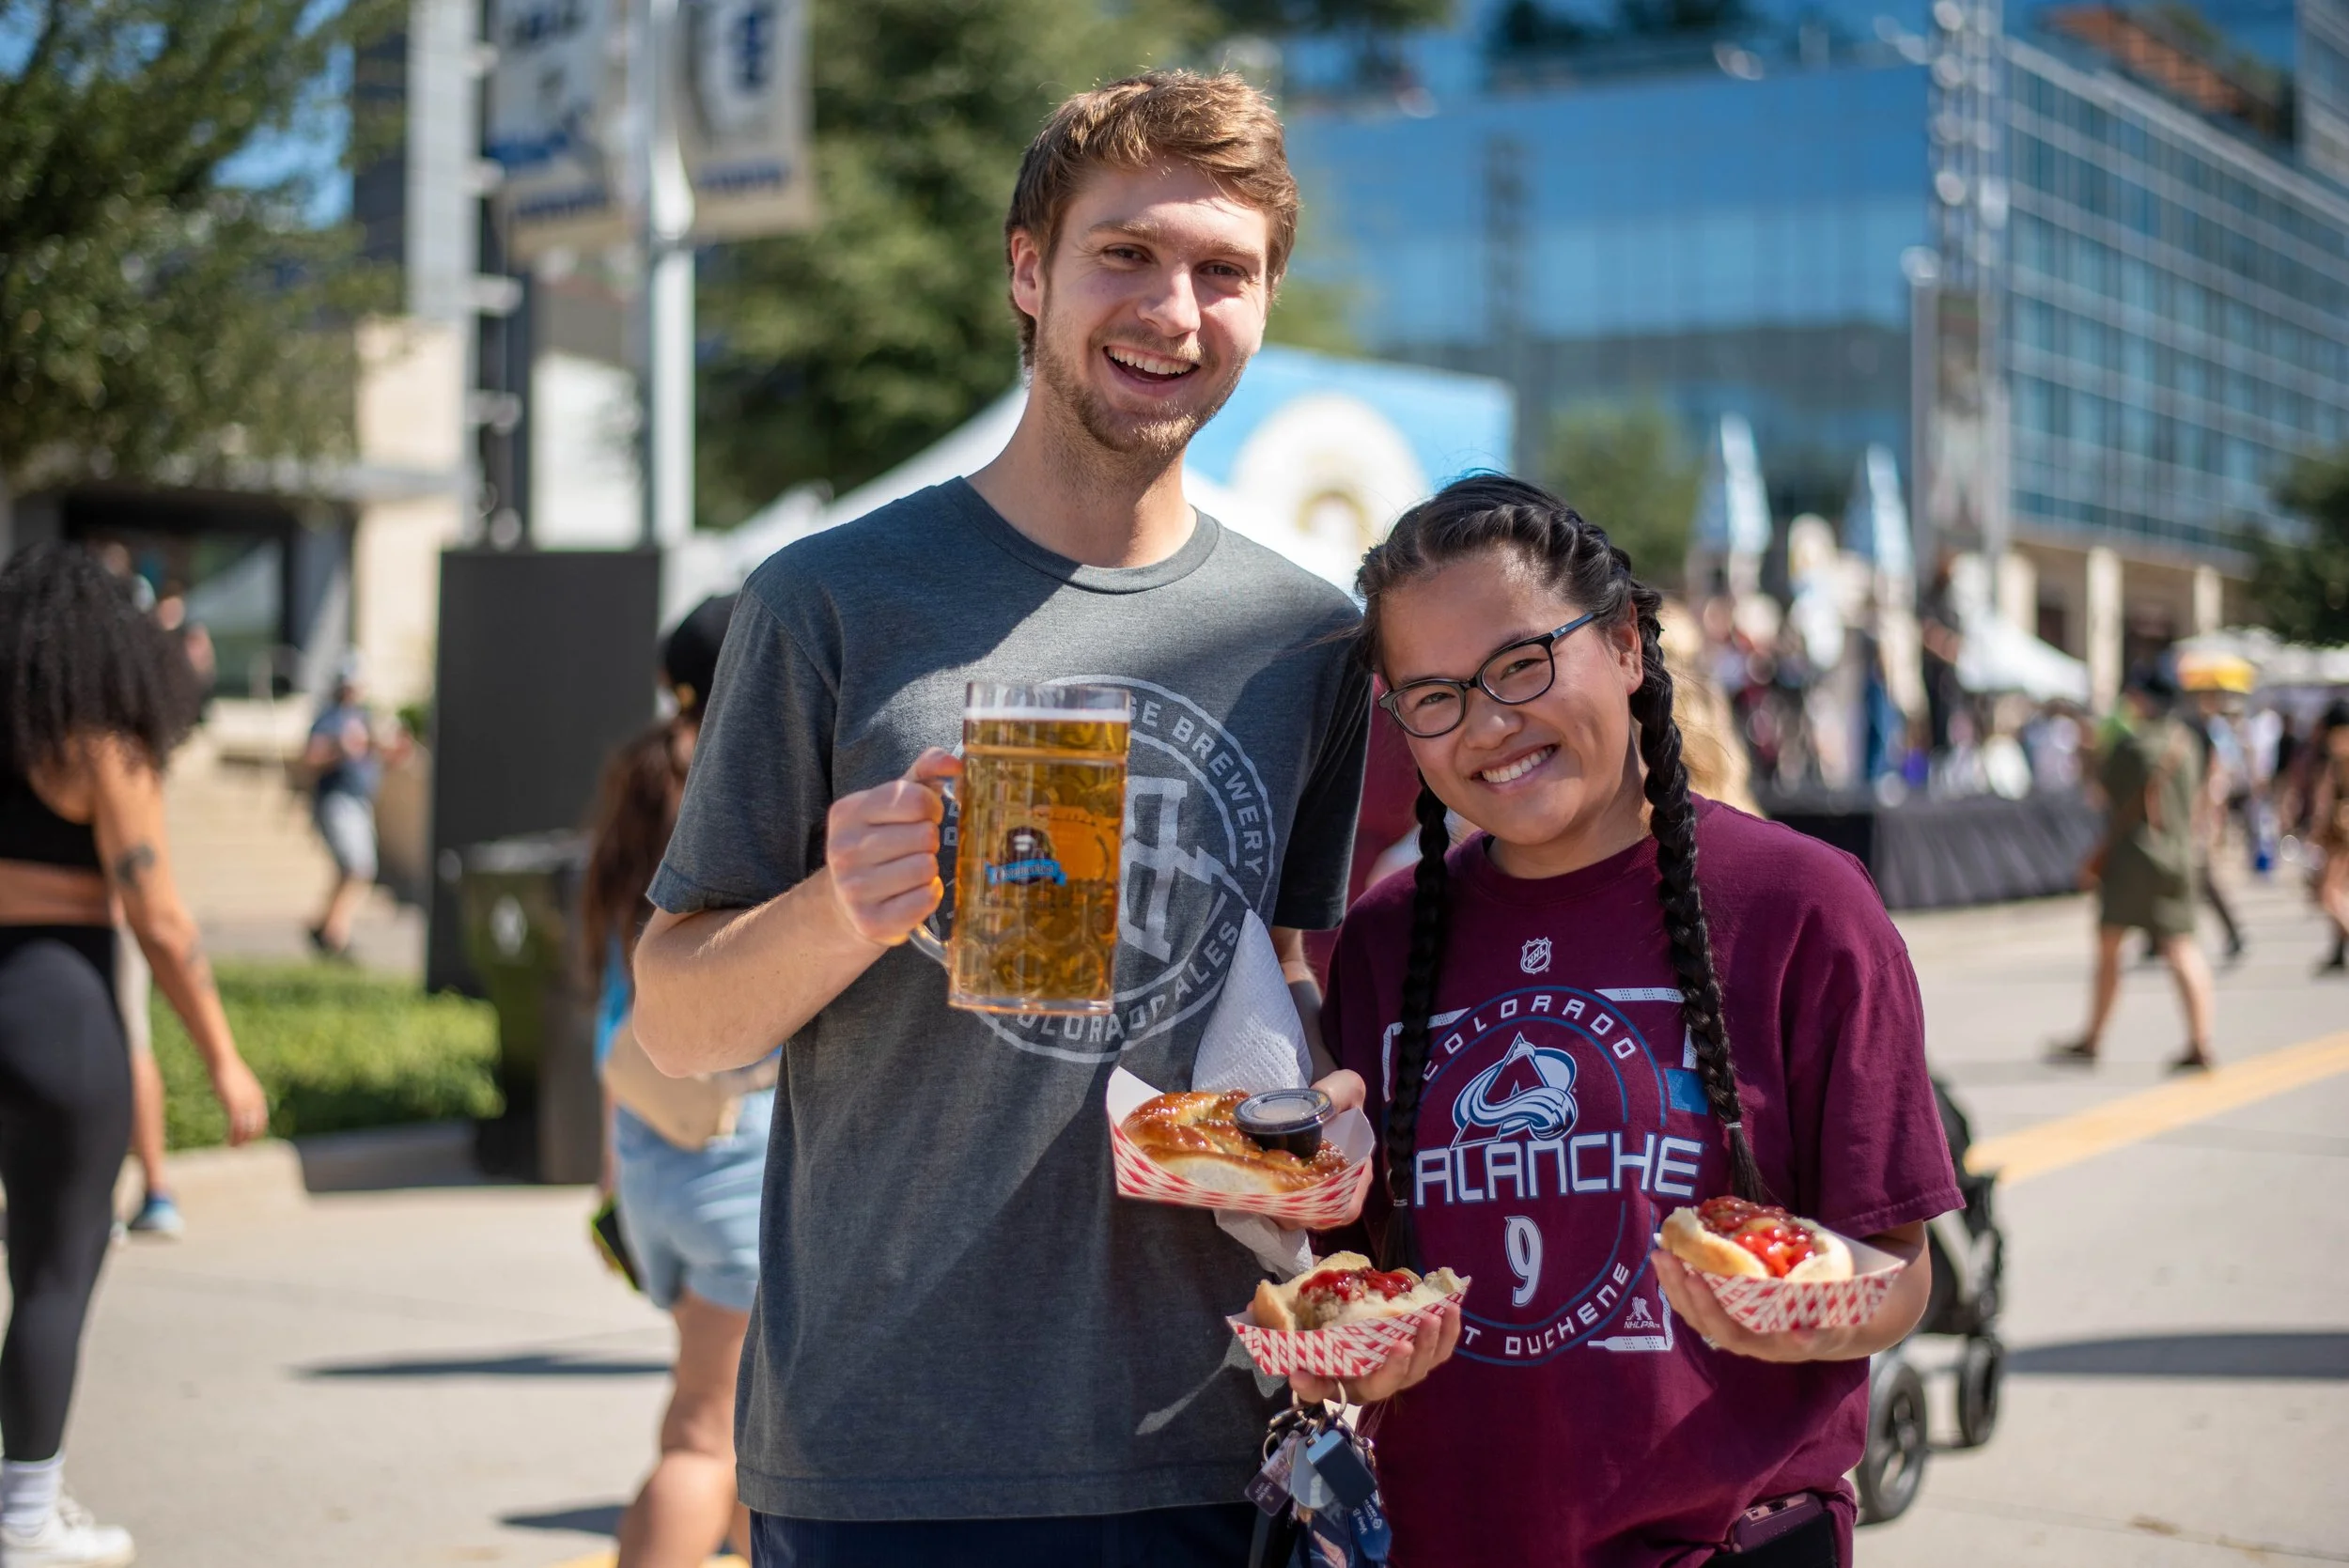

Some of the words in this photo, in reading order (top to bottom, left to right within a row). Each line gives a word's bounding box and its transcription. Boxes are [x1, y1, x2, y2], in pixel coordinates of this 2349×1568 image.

[1172, 716, 1264, 876] BREWERY
[1174, 921, 1239, 1002] ALES
[1527, 947, 1546, 967] NHL
[1414, 1131, 1703, 1207] ALANCHE
[1504, 1215, 1543, 1307] 9
[1505, 1263, 1629, 1355] DUCHENE
[1624, 1320, 1656, 1328] NHLPA
